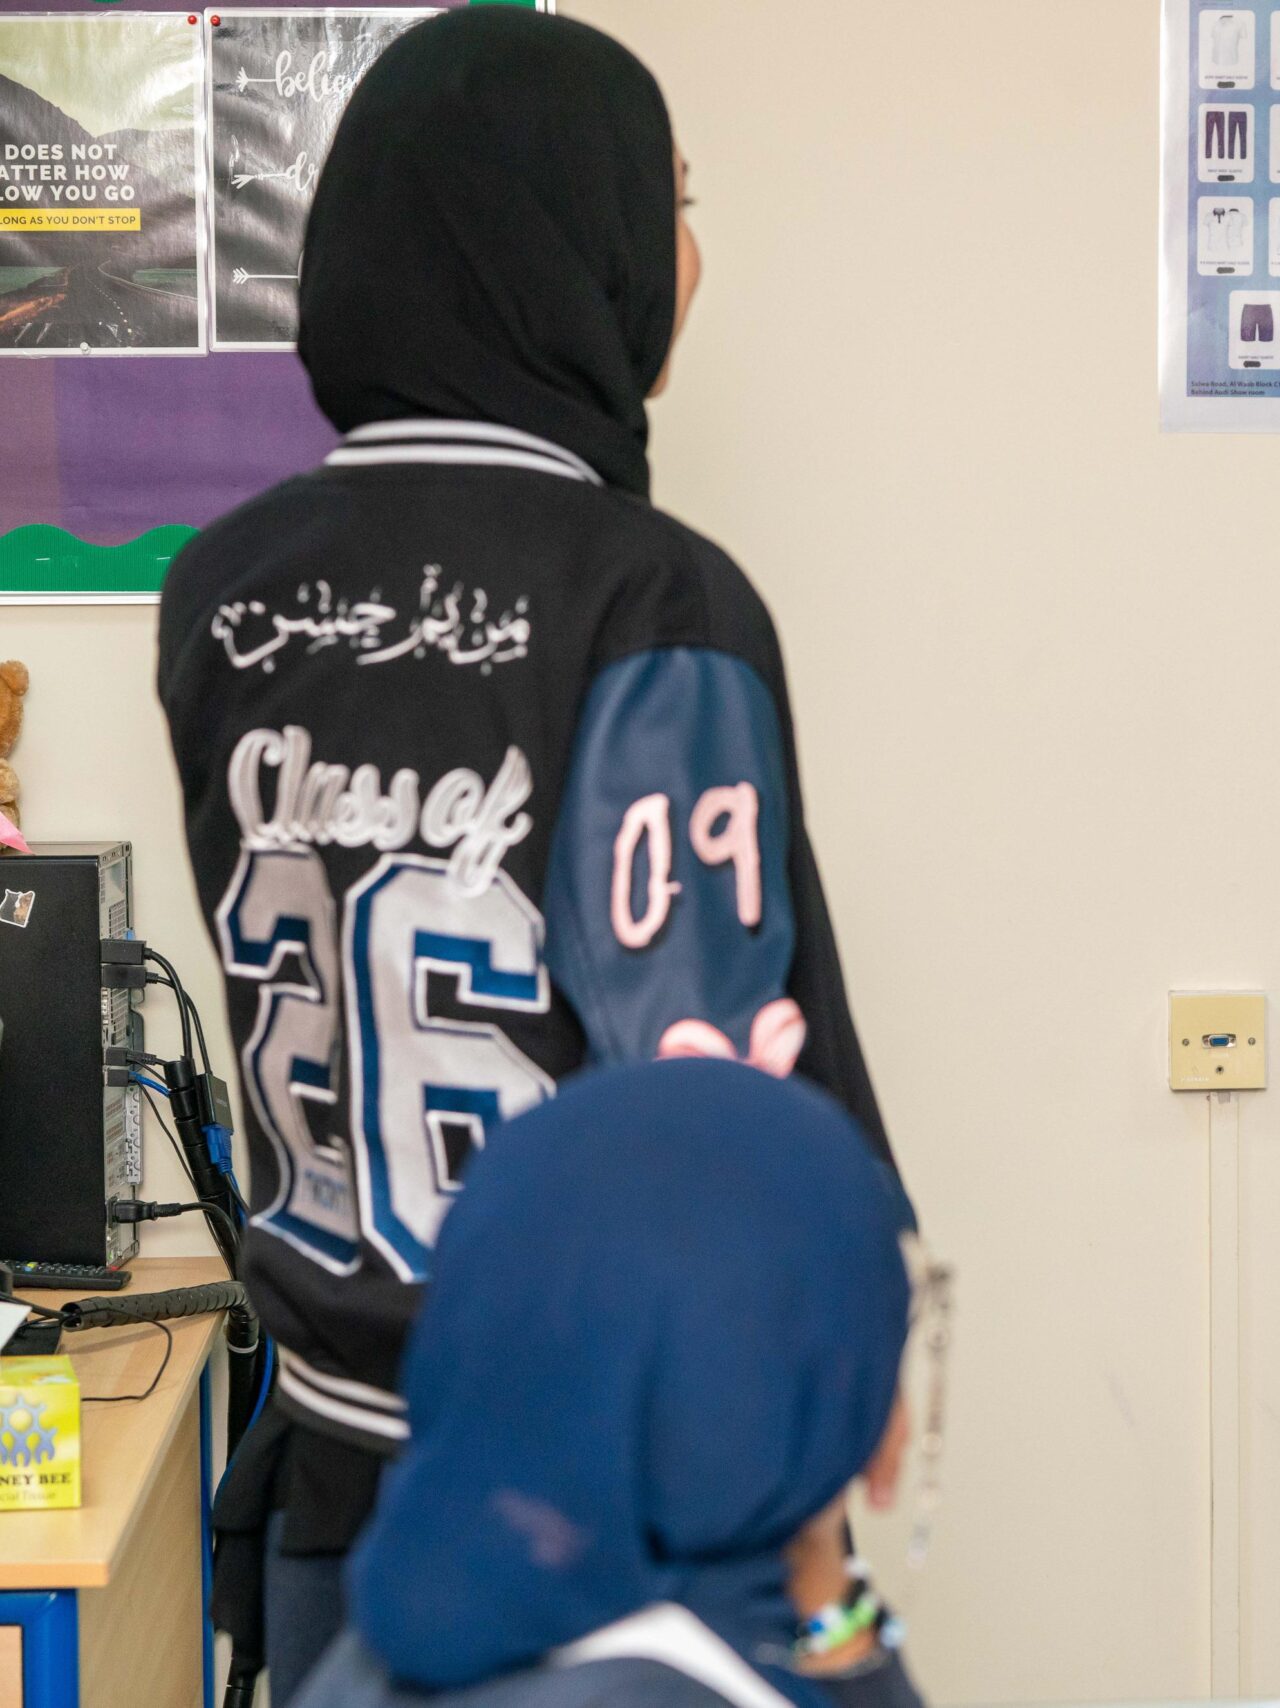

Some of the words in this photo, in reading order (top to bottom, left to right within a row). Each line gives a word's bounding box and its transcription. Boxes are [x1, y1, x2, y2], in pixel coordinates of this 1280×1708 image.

[4, 143, 64, 161] DOES
[71, 143, 118, 161] NOT
[0, 164, 68, 181] ATTER
[75, 164, 130, 181] HOW
[49, 184, 97, 201] YOU
[103, 184, 136, 201] GO
[29, 216, 44, 225] AS
[45, 216, 70, 225] YOU
[72, 215, 105, 225] DON'T
[107, 215, 137, 225] STOP
[227, 724, 420, 850] Class
[420, 744, 533, 899] of
[214, 840, 558, 1284] 26
[39, 1471, 72, 1485] BEE
